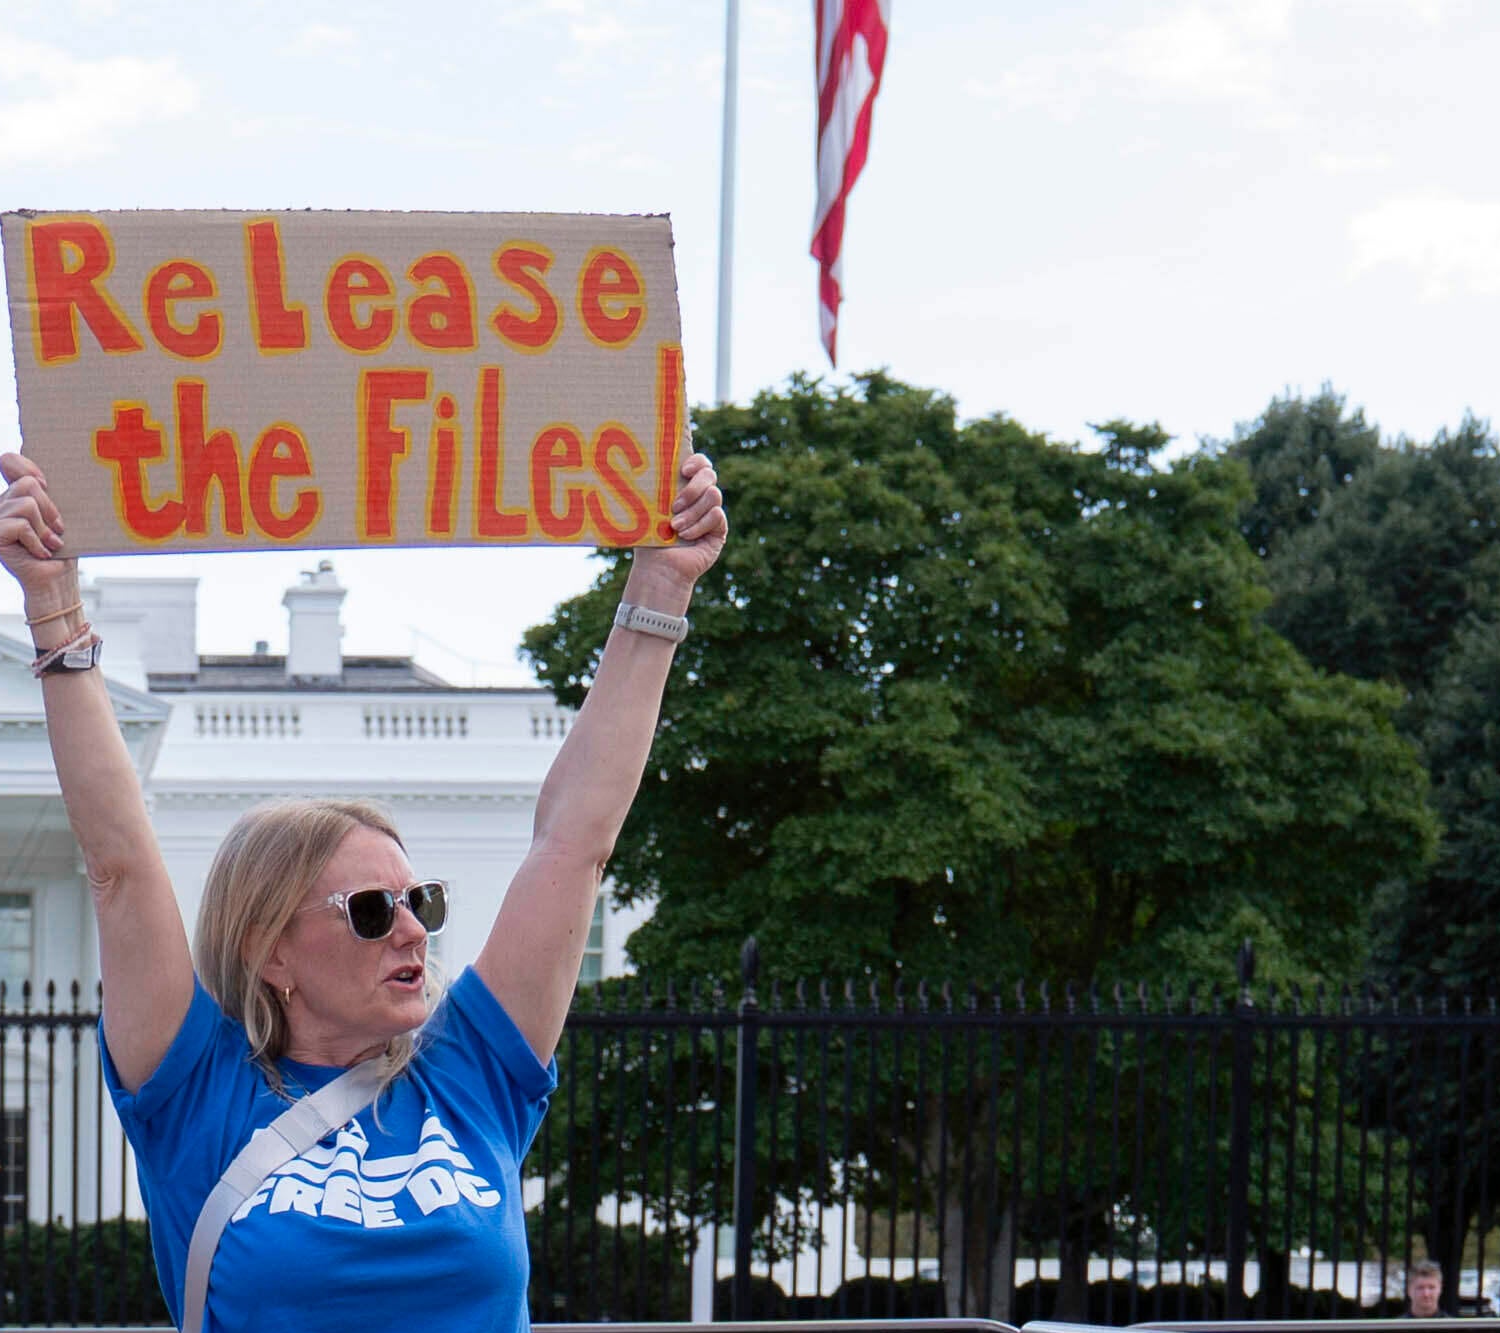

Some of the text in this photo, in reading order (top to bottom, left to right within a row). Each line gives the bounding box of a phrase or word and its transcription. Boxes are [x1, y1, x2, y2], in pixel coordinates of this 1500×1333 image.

[92, 376, 324, 543] the
[231, 1165, 501, 1229] FREE DC
